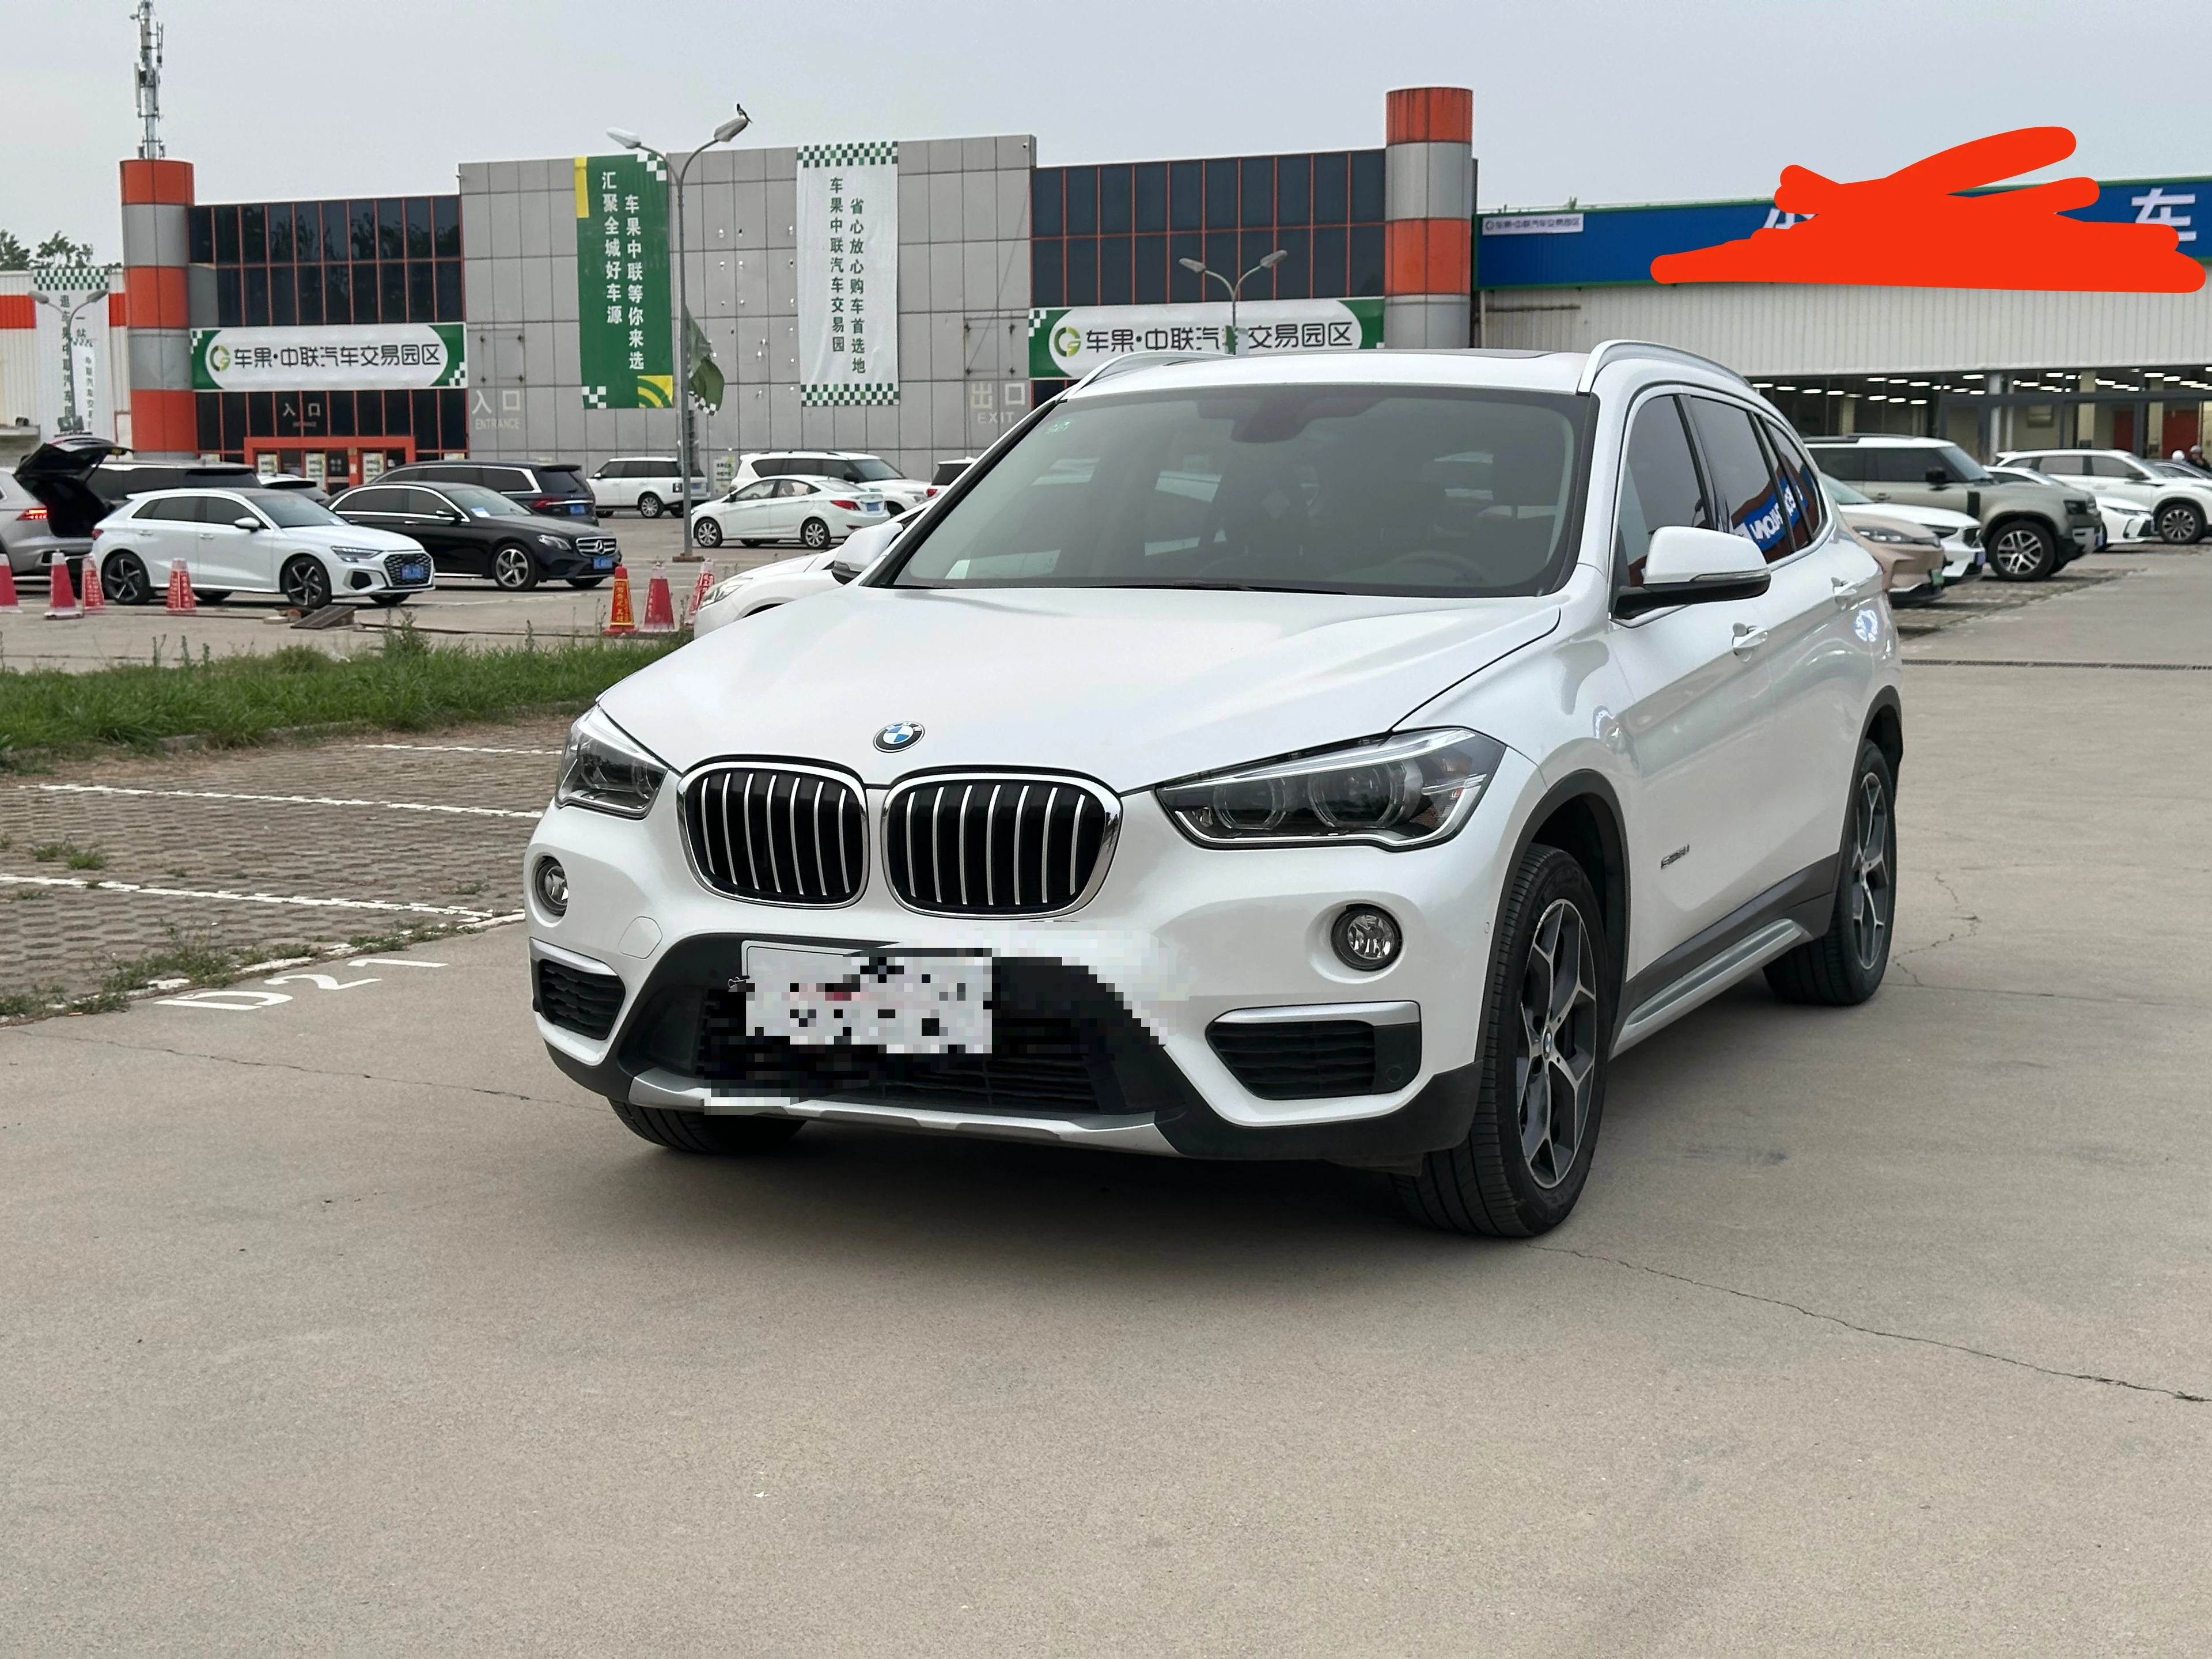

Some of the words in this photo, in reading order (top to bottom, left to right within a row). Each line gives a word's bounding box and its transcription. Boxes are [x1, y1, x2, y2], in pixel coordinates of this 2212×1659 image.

[601, 171, 623, 324] 汇聚全城好车源
[830, 177, 845, 353] 车果中联汽车交易园
[625, 194, 645, 370] 车果中联等你来选
[849, 198, 866, 374] 省心放心购车首选地
[282, 402, 321, 418] 入口
[472, 390, 520, 415] 入口
[970, 382, 1025, 410] 出口
[475, 418, 520, 430] ENTRANCE
[977, 411, 1016, 424] EXIT
